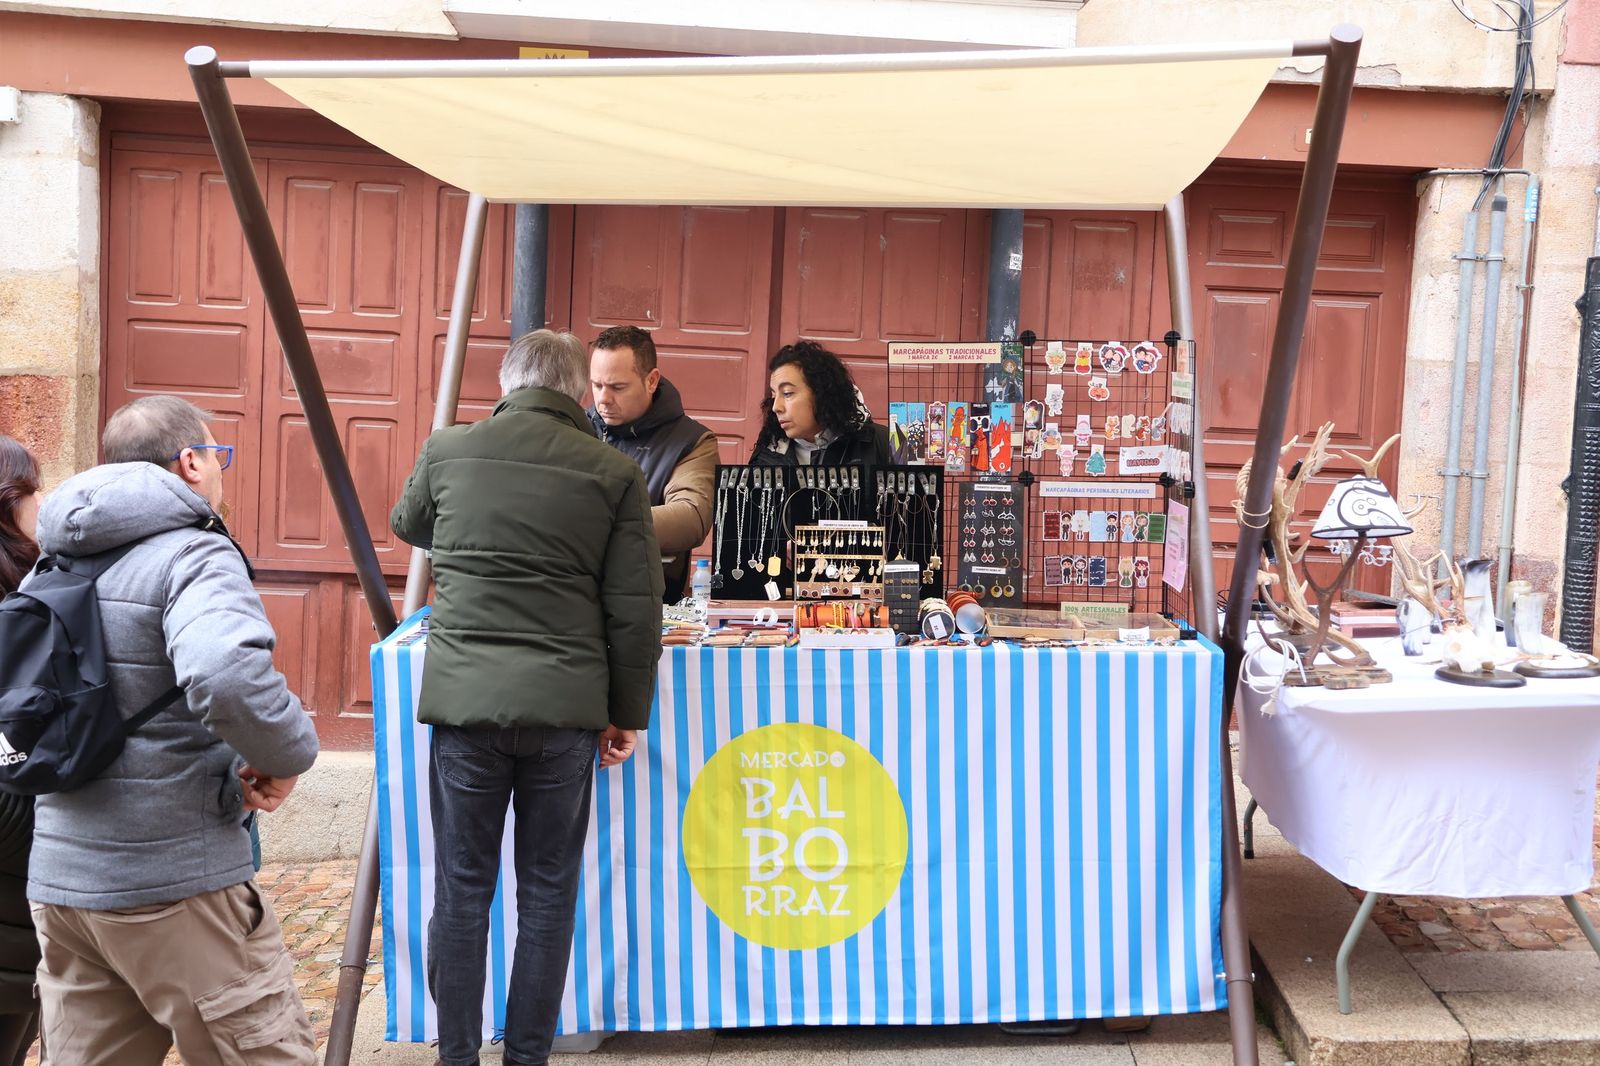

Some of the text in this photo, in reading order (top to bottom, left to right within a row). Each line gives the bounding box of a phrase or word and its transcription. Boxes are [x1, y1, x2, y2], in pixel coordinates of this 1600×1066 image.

[893, 346, 944, 355] MARCAPÁGINAS
[1126, 458, 1160, 467] NAVIDAD
[1081, 605, 1127, 614] ARTESANALES
[740, 751, 847, 769] MERCADO
[740, 776, 846, 820] BAL
[742, 826, 849, 882] BO
[741, 884, 850, 917] RRAZ
